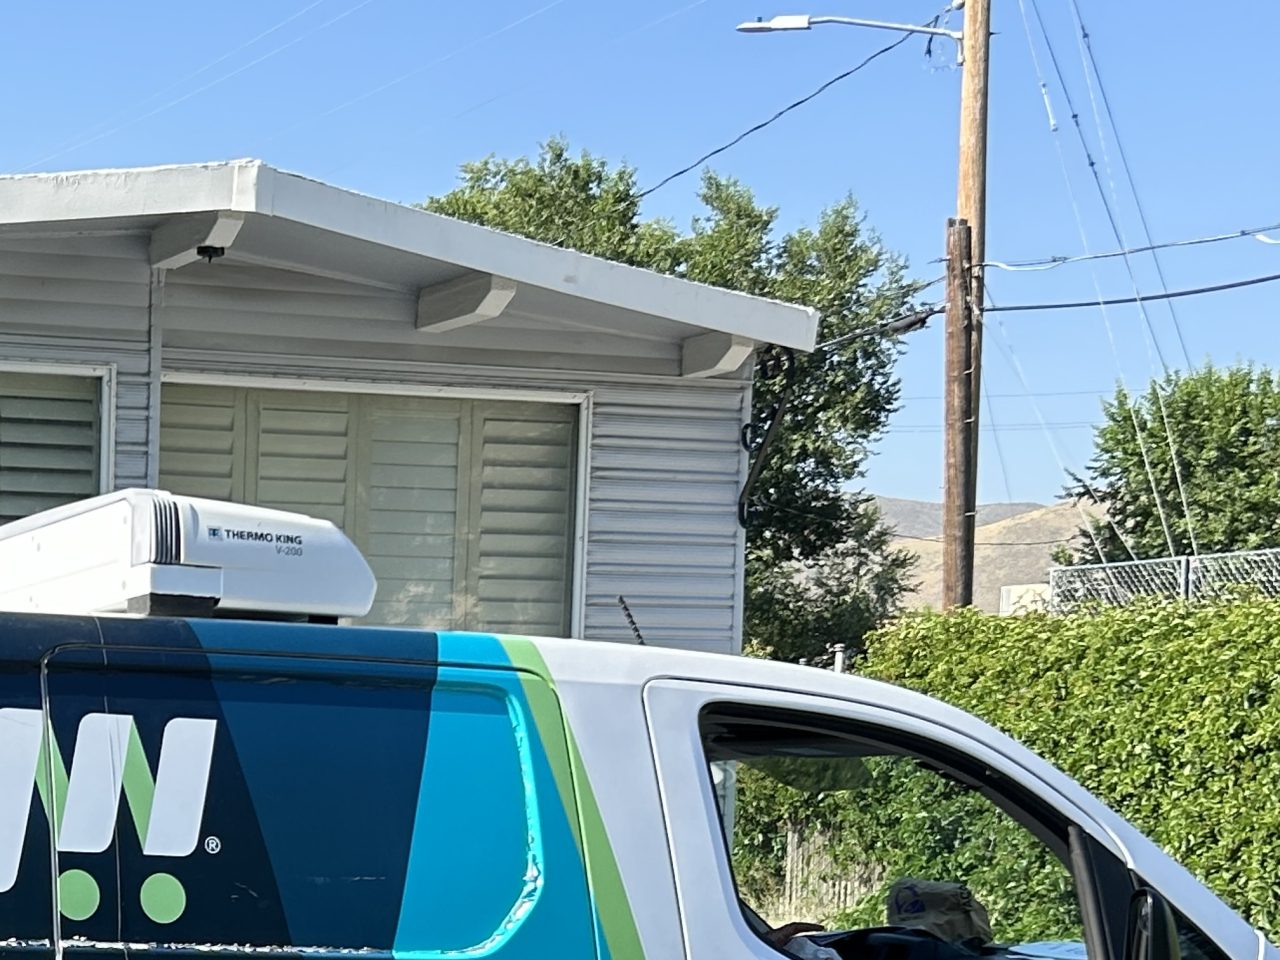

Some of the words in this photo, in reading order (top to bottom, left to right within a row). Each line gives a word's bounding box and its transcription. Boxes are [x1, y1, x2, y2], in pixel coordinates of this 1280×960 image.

[224, 528, 273, 544] THERMO
[275, 533, 303, 546] KING
[275, 544, 303, 557] V-200
